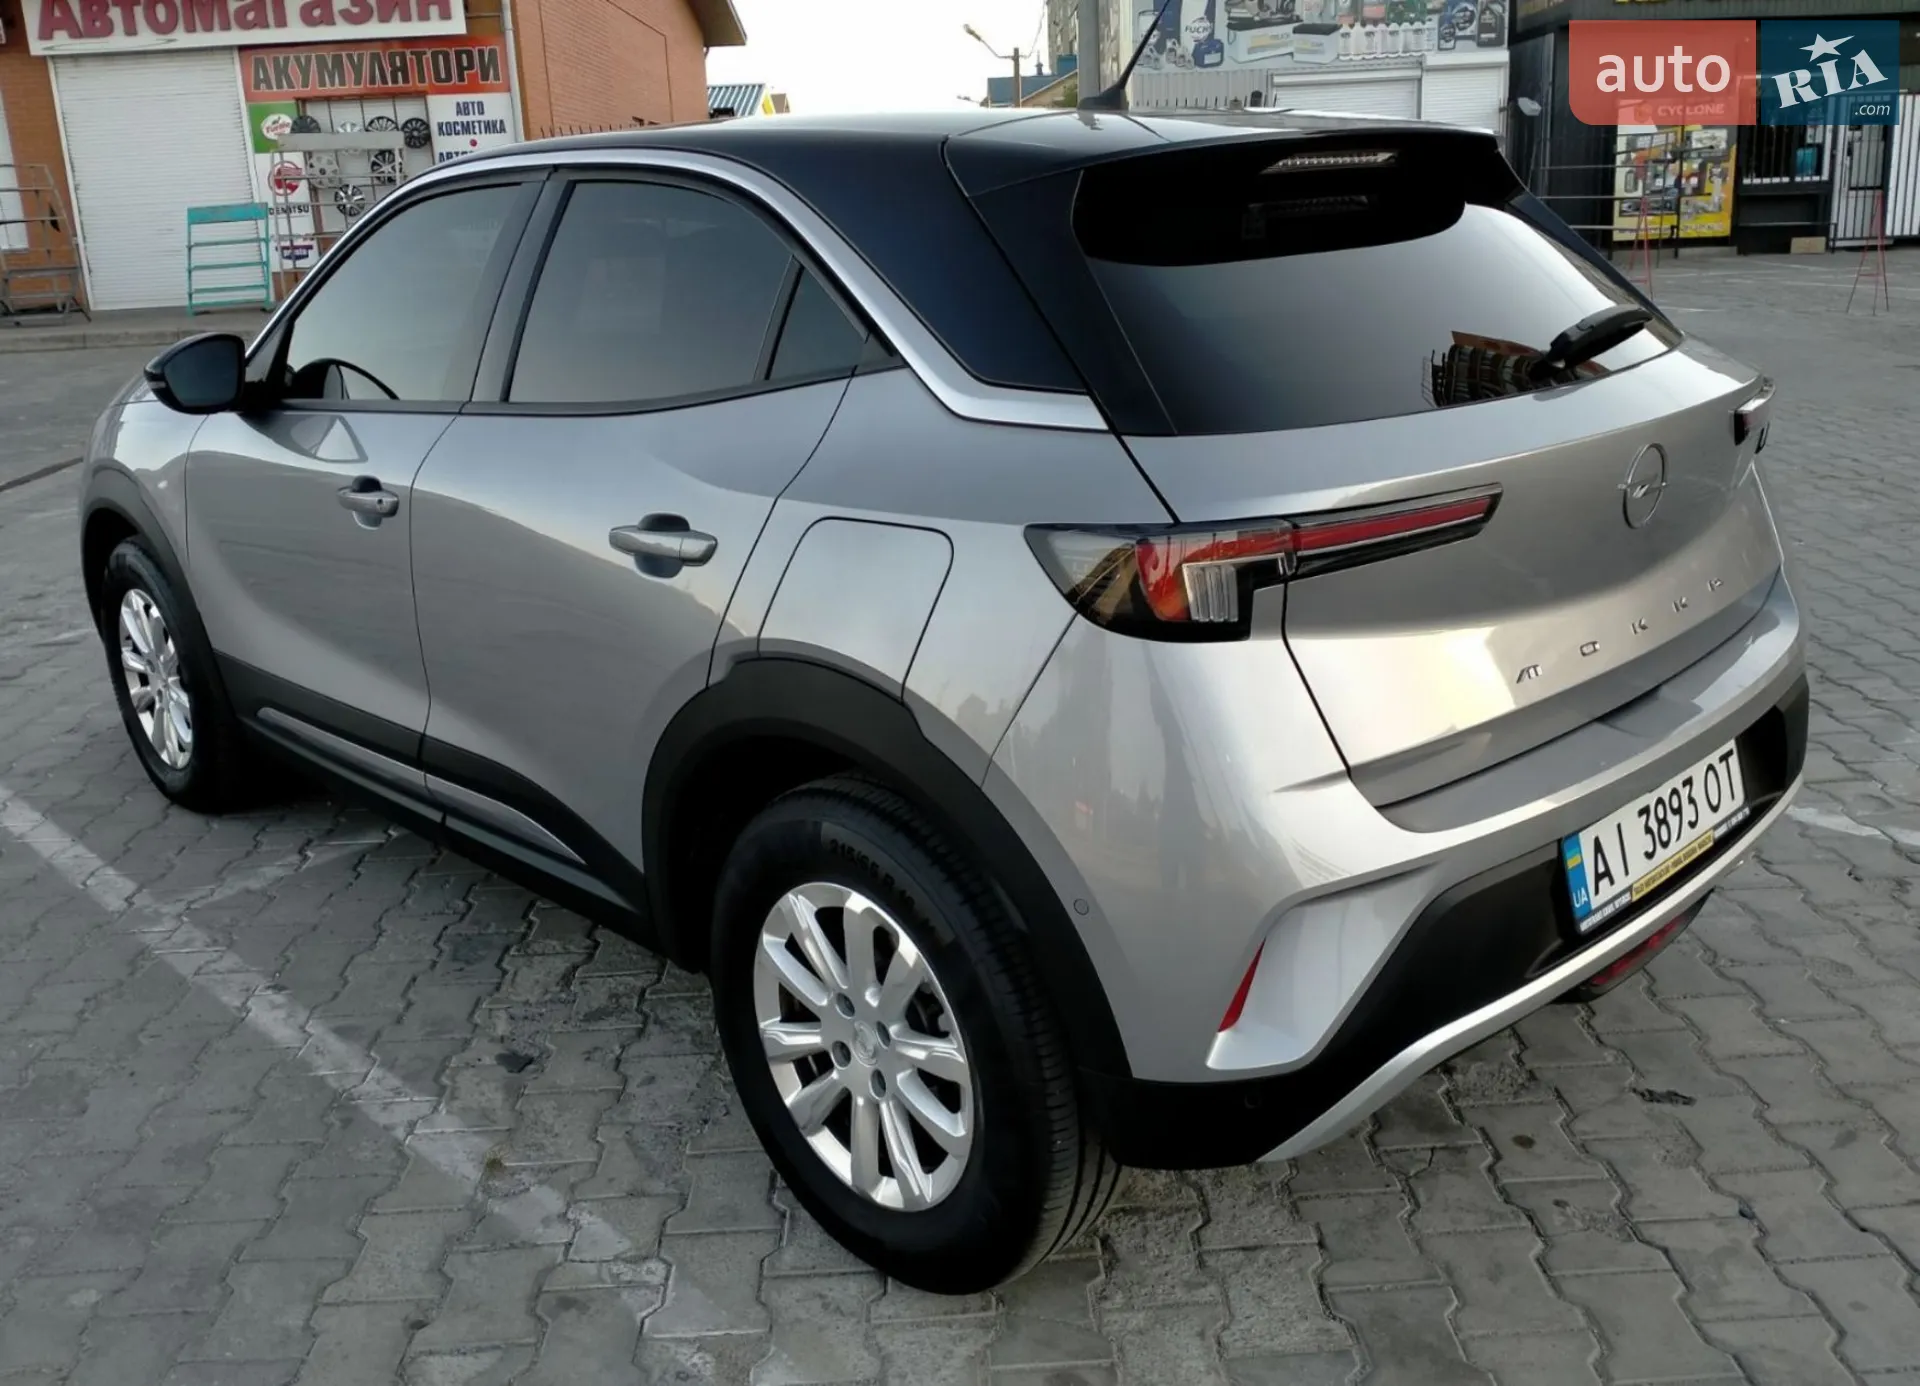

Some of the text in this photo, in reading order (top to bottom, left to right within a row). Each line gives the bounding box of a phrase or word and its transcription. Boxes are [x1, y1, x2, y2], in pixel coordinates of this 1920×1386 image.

[251, 46, 502, 92] АКУМУЛЯТОРИ
[456, 101, 485, 116] АВТО
[1657, 103, 1726, 117] CYCLONE
[437, 119, 507, 137] КОСМЕТИКА
[1593, 822, 1630, 897] AI
[1637, 774, 1699, 861] 3893
[1703, 747, 1735, 814] OT
[1573, 889, 1589, 908] UA
